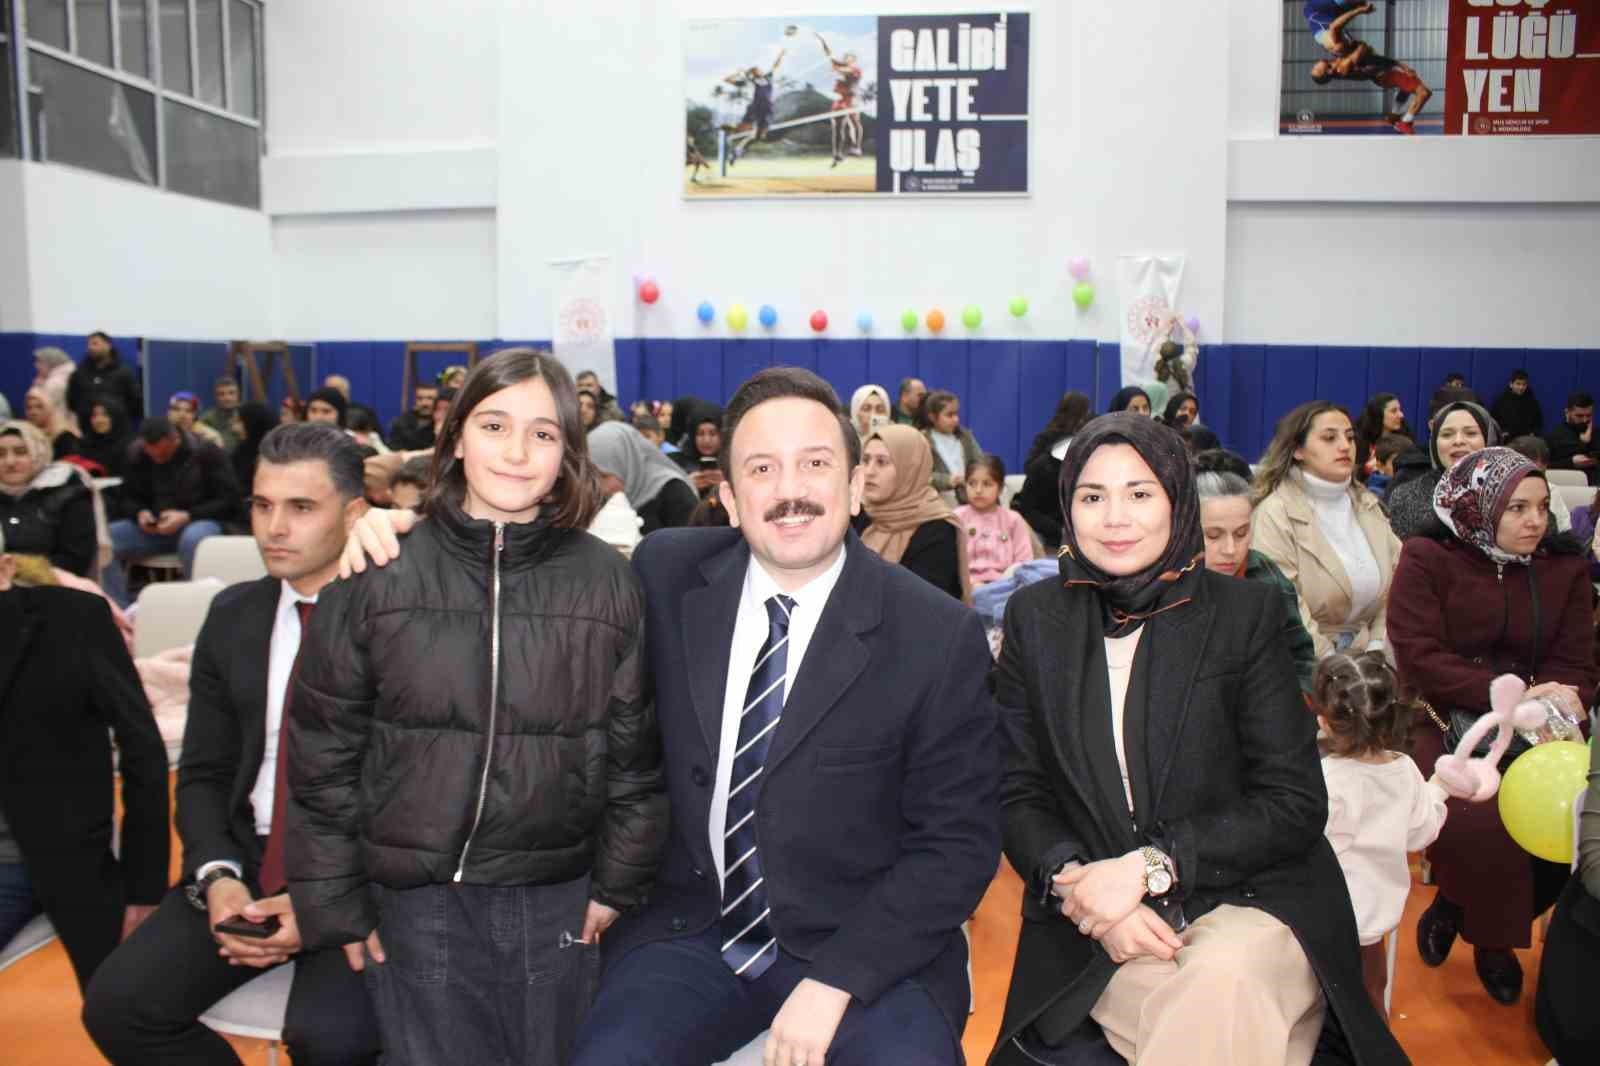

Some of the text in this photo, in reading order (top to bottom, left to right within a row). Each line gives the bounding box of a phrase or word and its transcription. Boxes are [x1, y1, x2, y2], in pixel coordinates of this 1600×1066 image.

[891, 22, 1007, 71] GALİBİ
[1465, 9, 1577, 60] LÜĞÜ
[889, 79, 979, 121] YETE
[1462, 69, 1541, 112] YEN
[889, 129, 980, 176] ULAŞ
